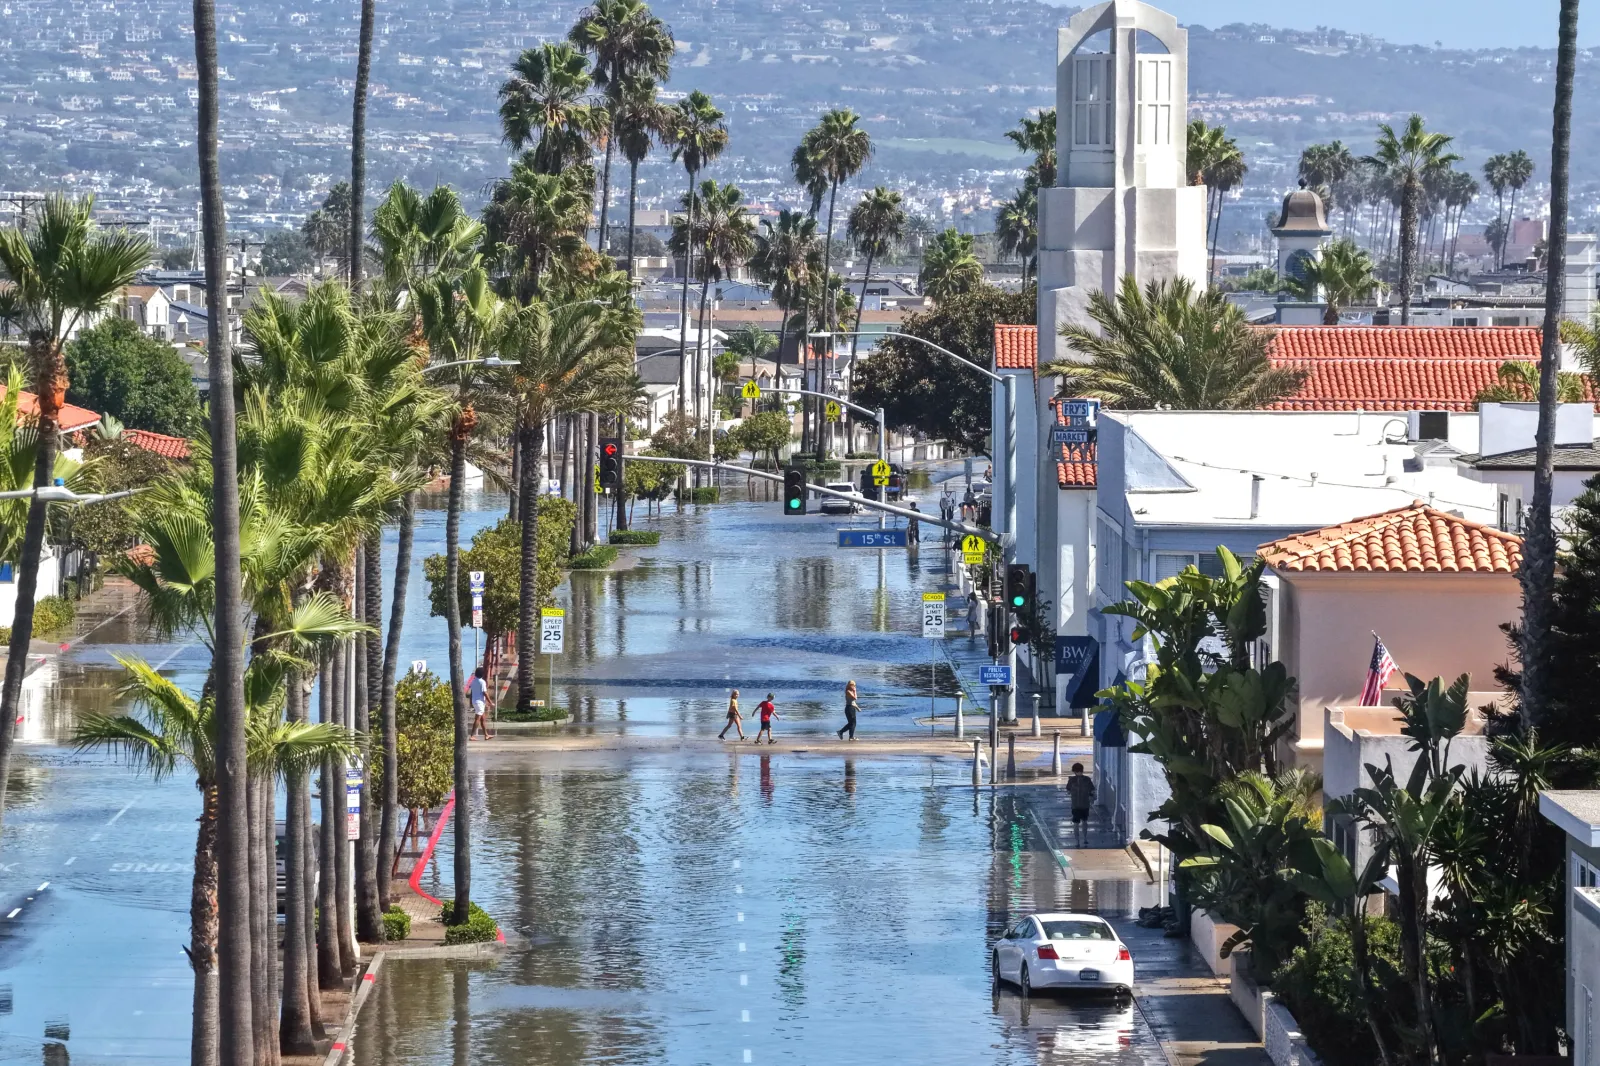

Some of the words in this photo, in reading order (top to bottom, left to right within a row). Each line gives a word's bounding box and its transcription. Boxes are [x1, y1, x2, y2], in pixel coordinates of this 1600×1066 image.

[1064, 403, 1087, 415] FRY'S
[1073, 417, 1082, 426] 15
[1055, 432, 1086, 441] MARKET
[861, 533, 881, 545] 15th
[883, 534, 896, 545] St
[924, 615, 943, 626] 25
[543, 630, 562, 641] 25
[1062, 645, 1087, 659] BW
